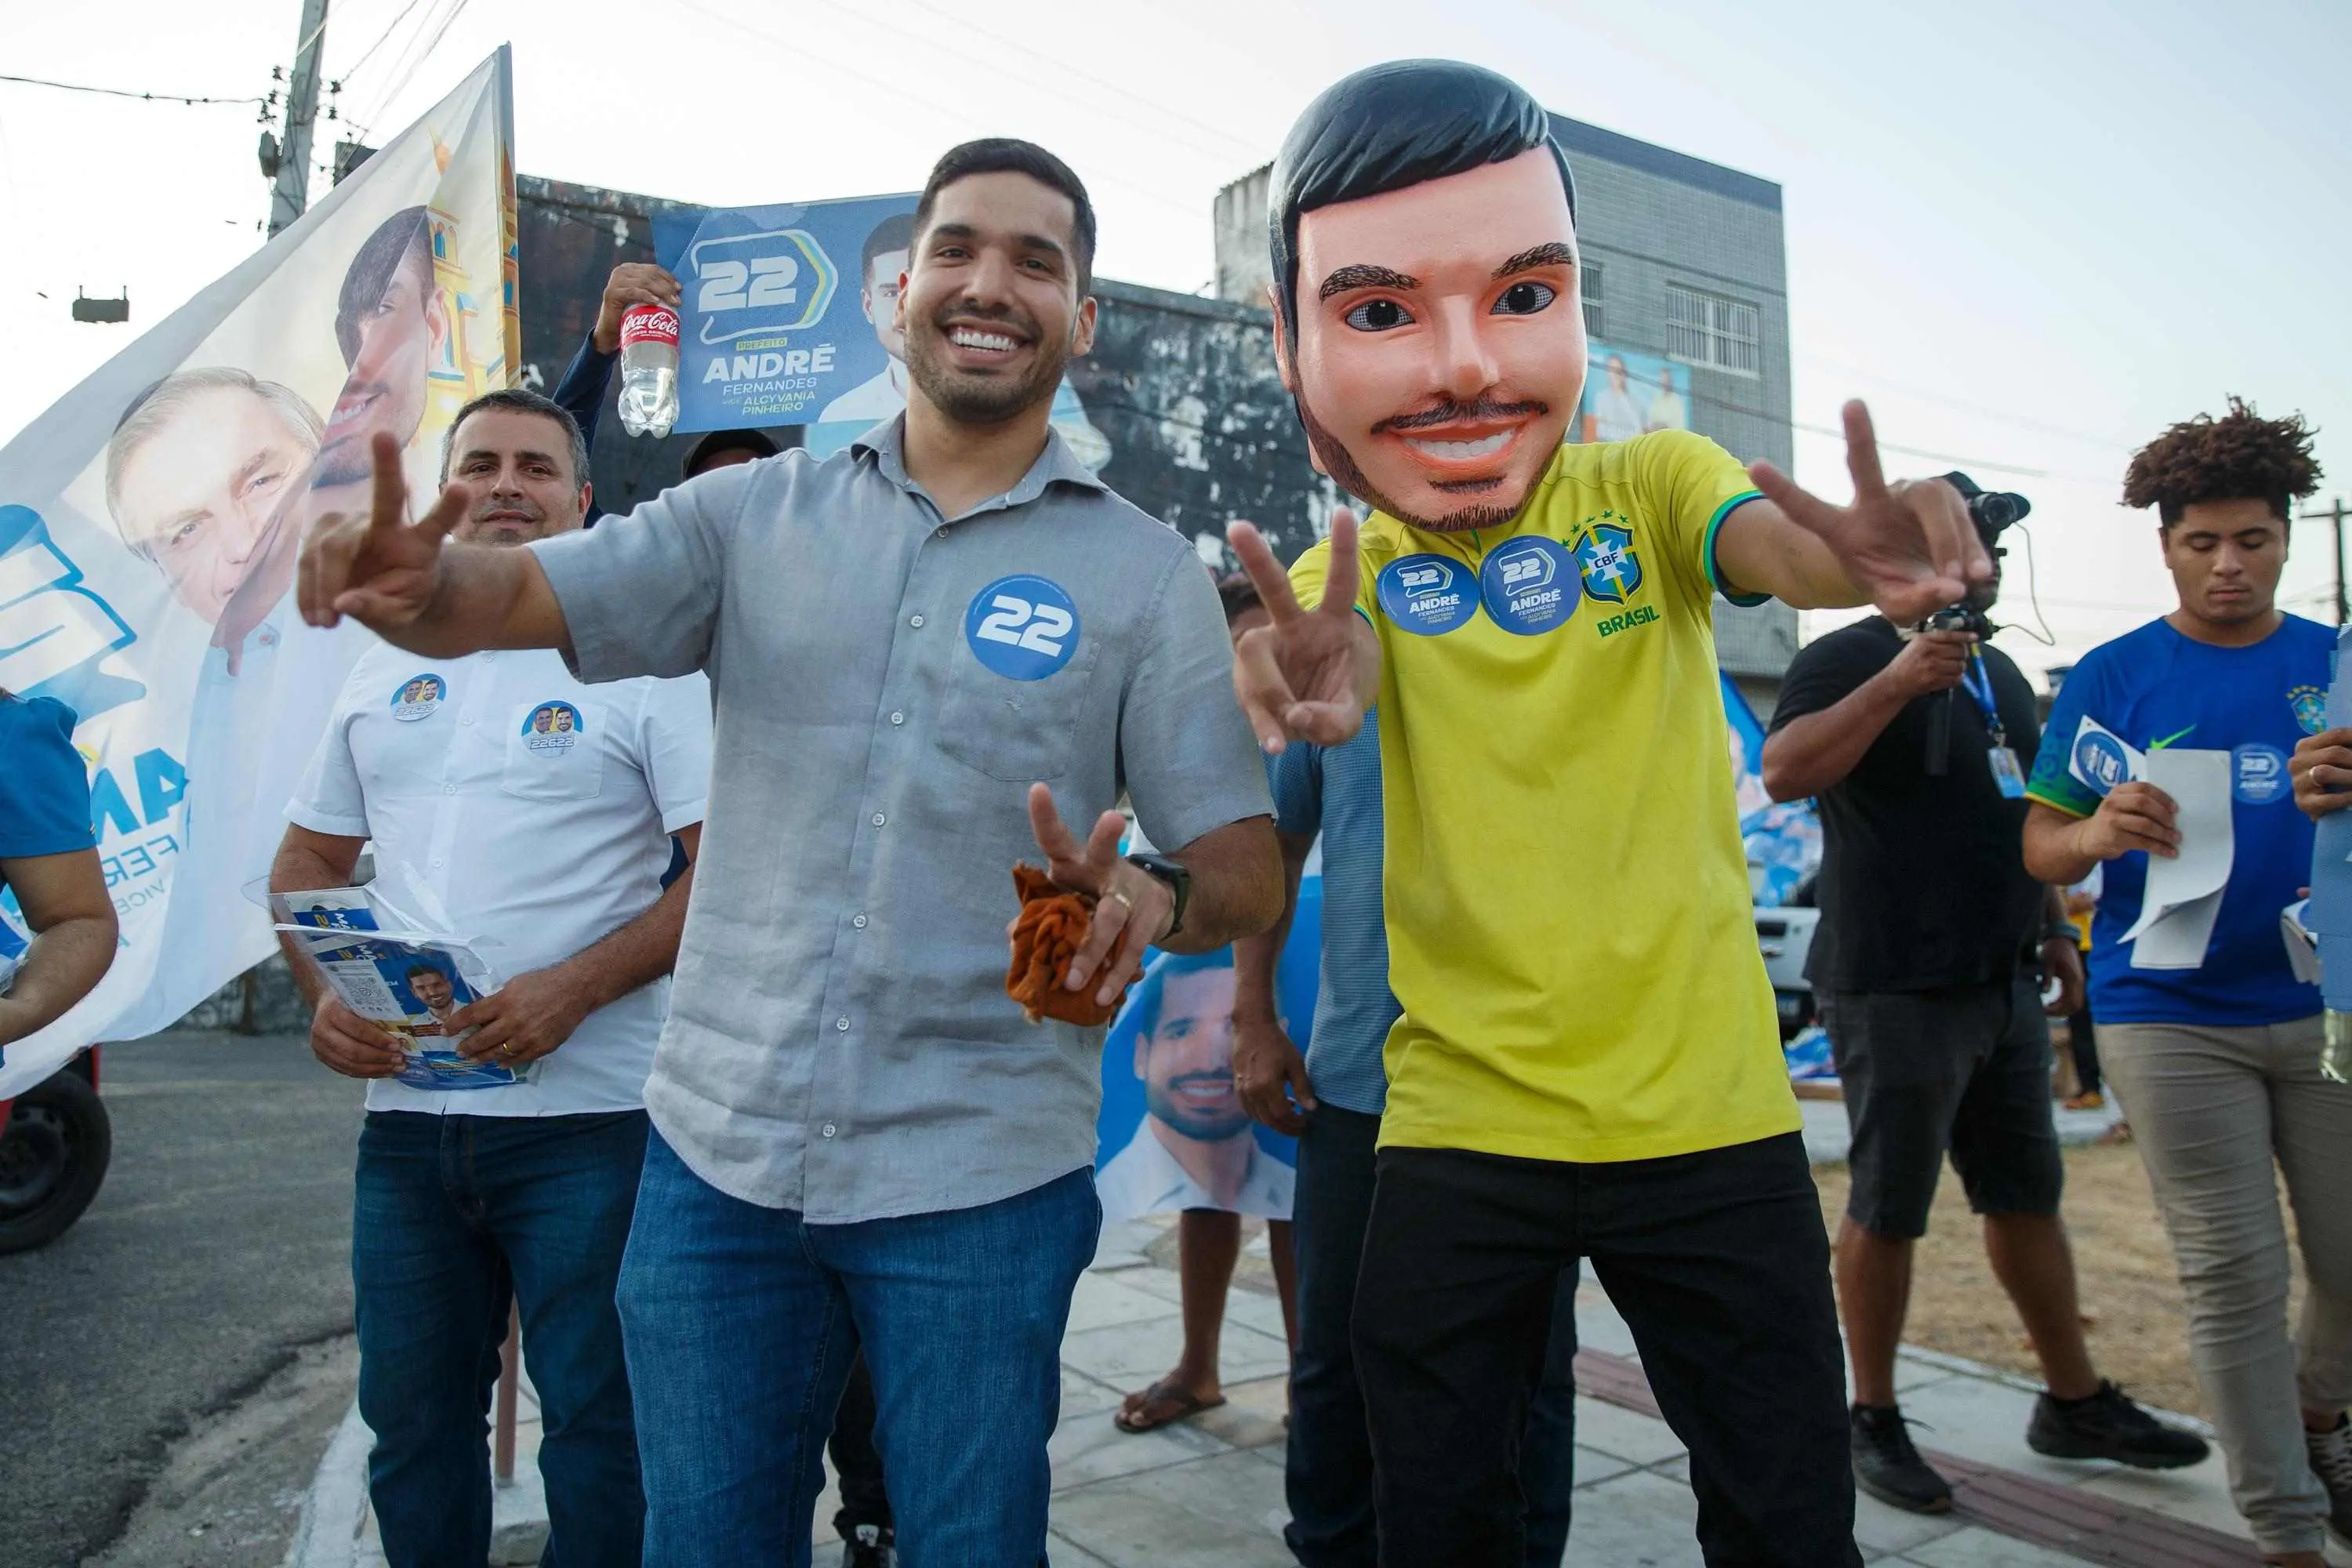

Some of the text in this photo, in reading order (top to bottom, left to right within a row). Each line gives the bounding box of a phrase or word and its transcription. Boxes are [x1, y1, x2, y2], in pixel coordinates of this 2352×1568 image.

[698, 256, 799, 313] 22
[702, 343, 837, 383] ANDRÉ
[723, 377, 817, 395] FERNANDES
[742, 401, 804, 416] PINHEIRO
[744, 392, 815, 406] ALCYVANIA
[1594, 552, 1619, 568] CBF
[1402, 569, 1439, 587] 22
[1503, 557, 1541, 584] 22
[1409, 593, 1461, 613] ANDRÉ
[1510, 588, 1561, 613] ANDRÉ
[977, 594, 1073, 658] 22
[1597, 605, 1661, 637] BRASIL
[530, 738, 574, 750] 22622
